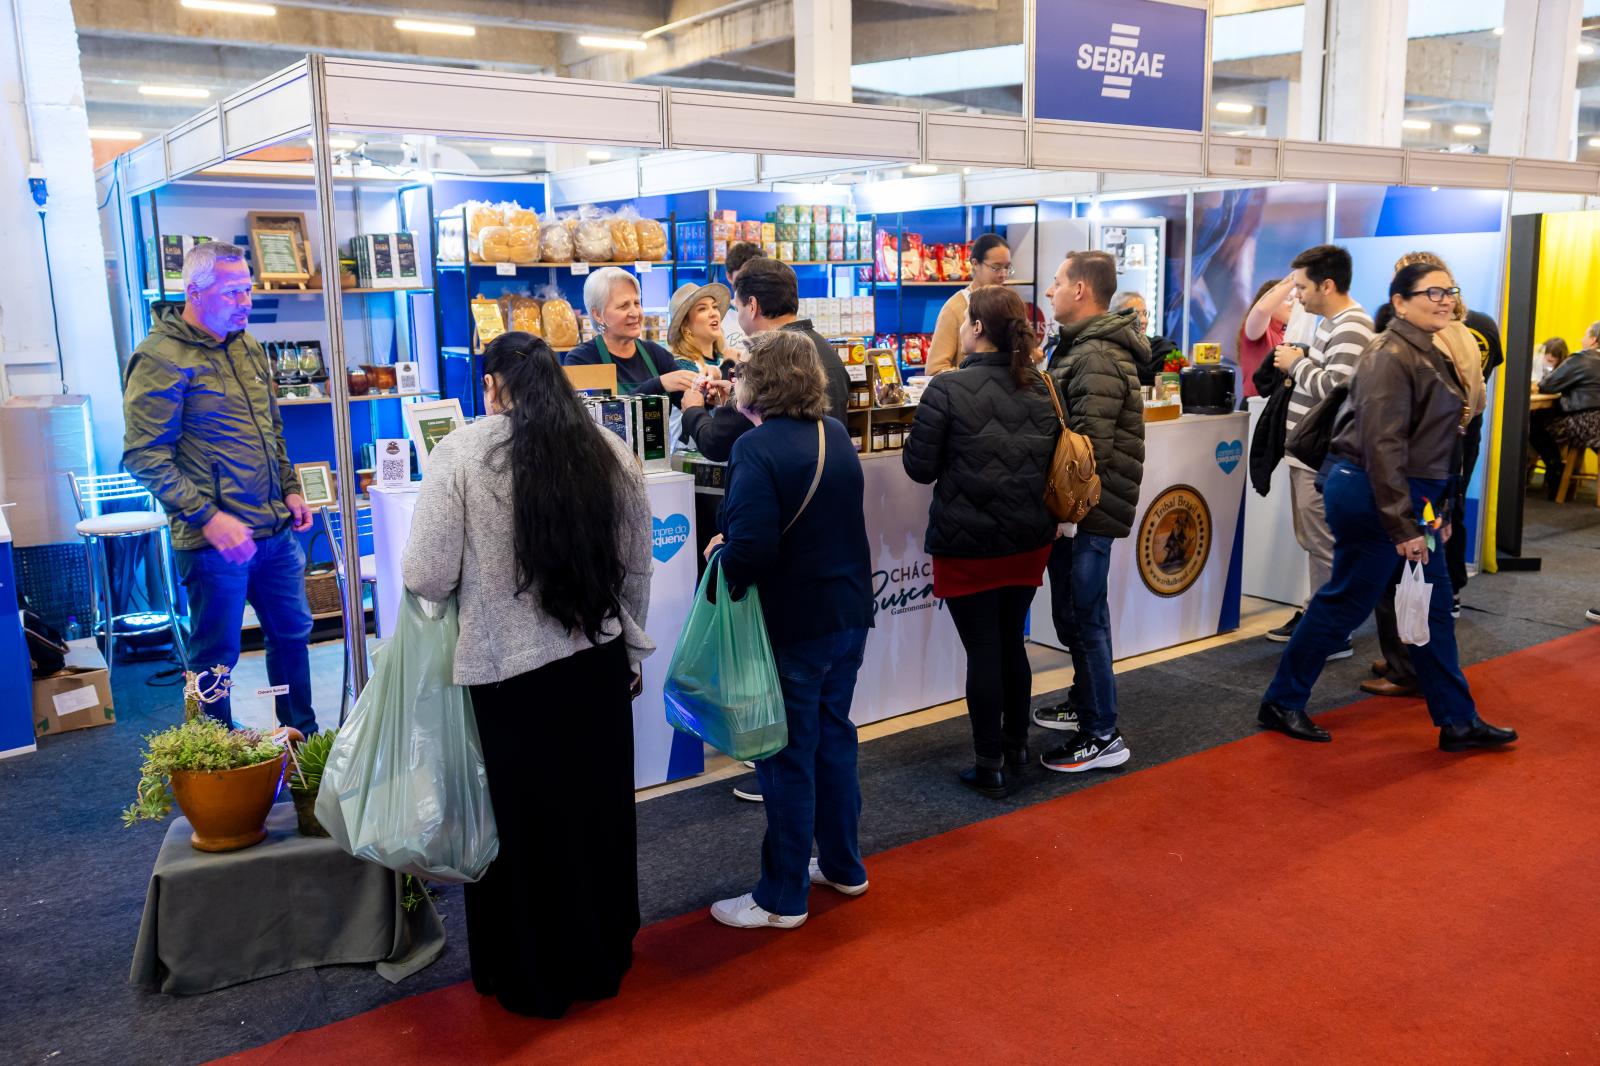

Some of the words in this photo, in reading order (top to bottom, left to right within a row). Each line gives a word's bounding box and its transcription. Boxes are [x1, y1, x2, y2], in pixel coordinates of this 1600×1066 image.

[1076, 43, 1166, 79] SEBRAE
[1153, 497, 1176, 518] Tribal
[1178, 495, 1199, 513] Brasil
[652, 527, 674, 538] mpre
[675, 524, 687, 534] do
[652, 534, 687, 548] queno
[890, 561, 934, 583] CHÁC
[891, 601, 931, 616] Gastronomia
[1057, 711, 1078, 722] FILA
[1074, 744, 1099, 762] FILA
